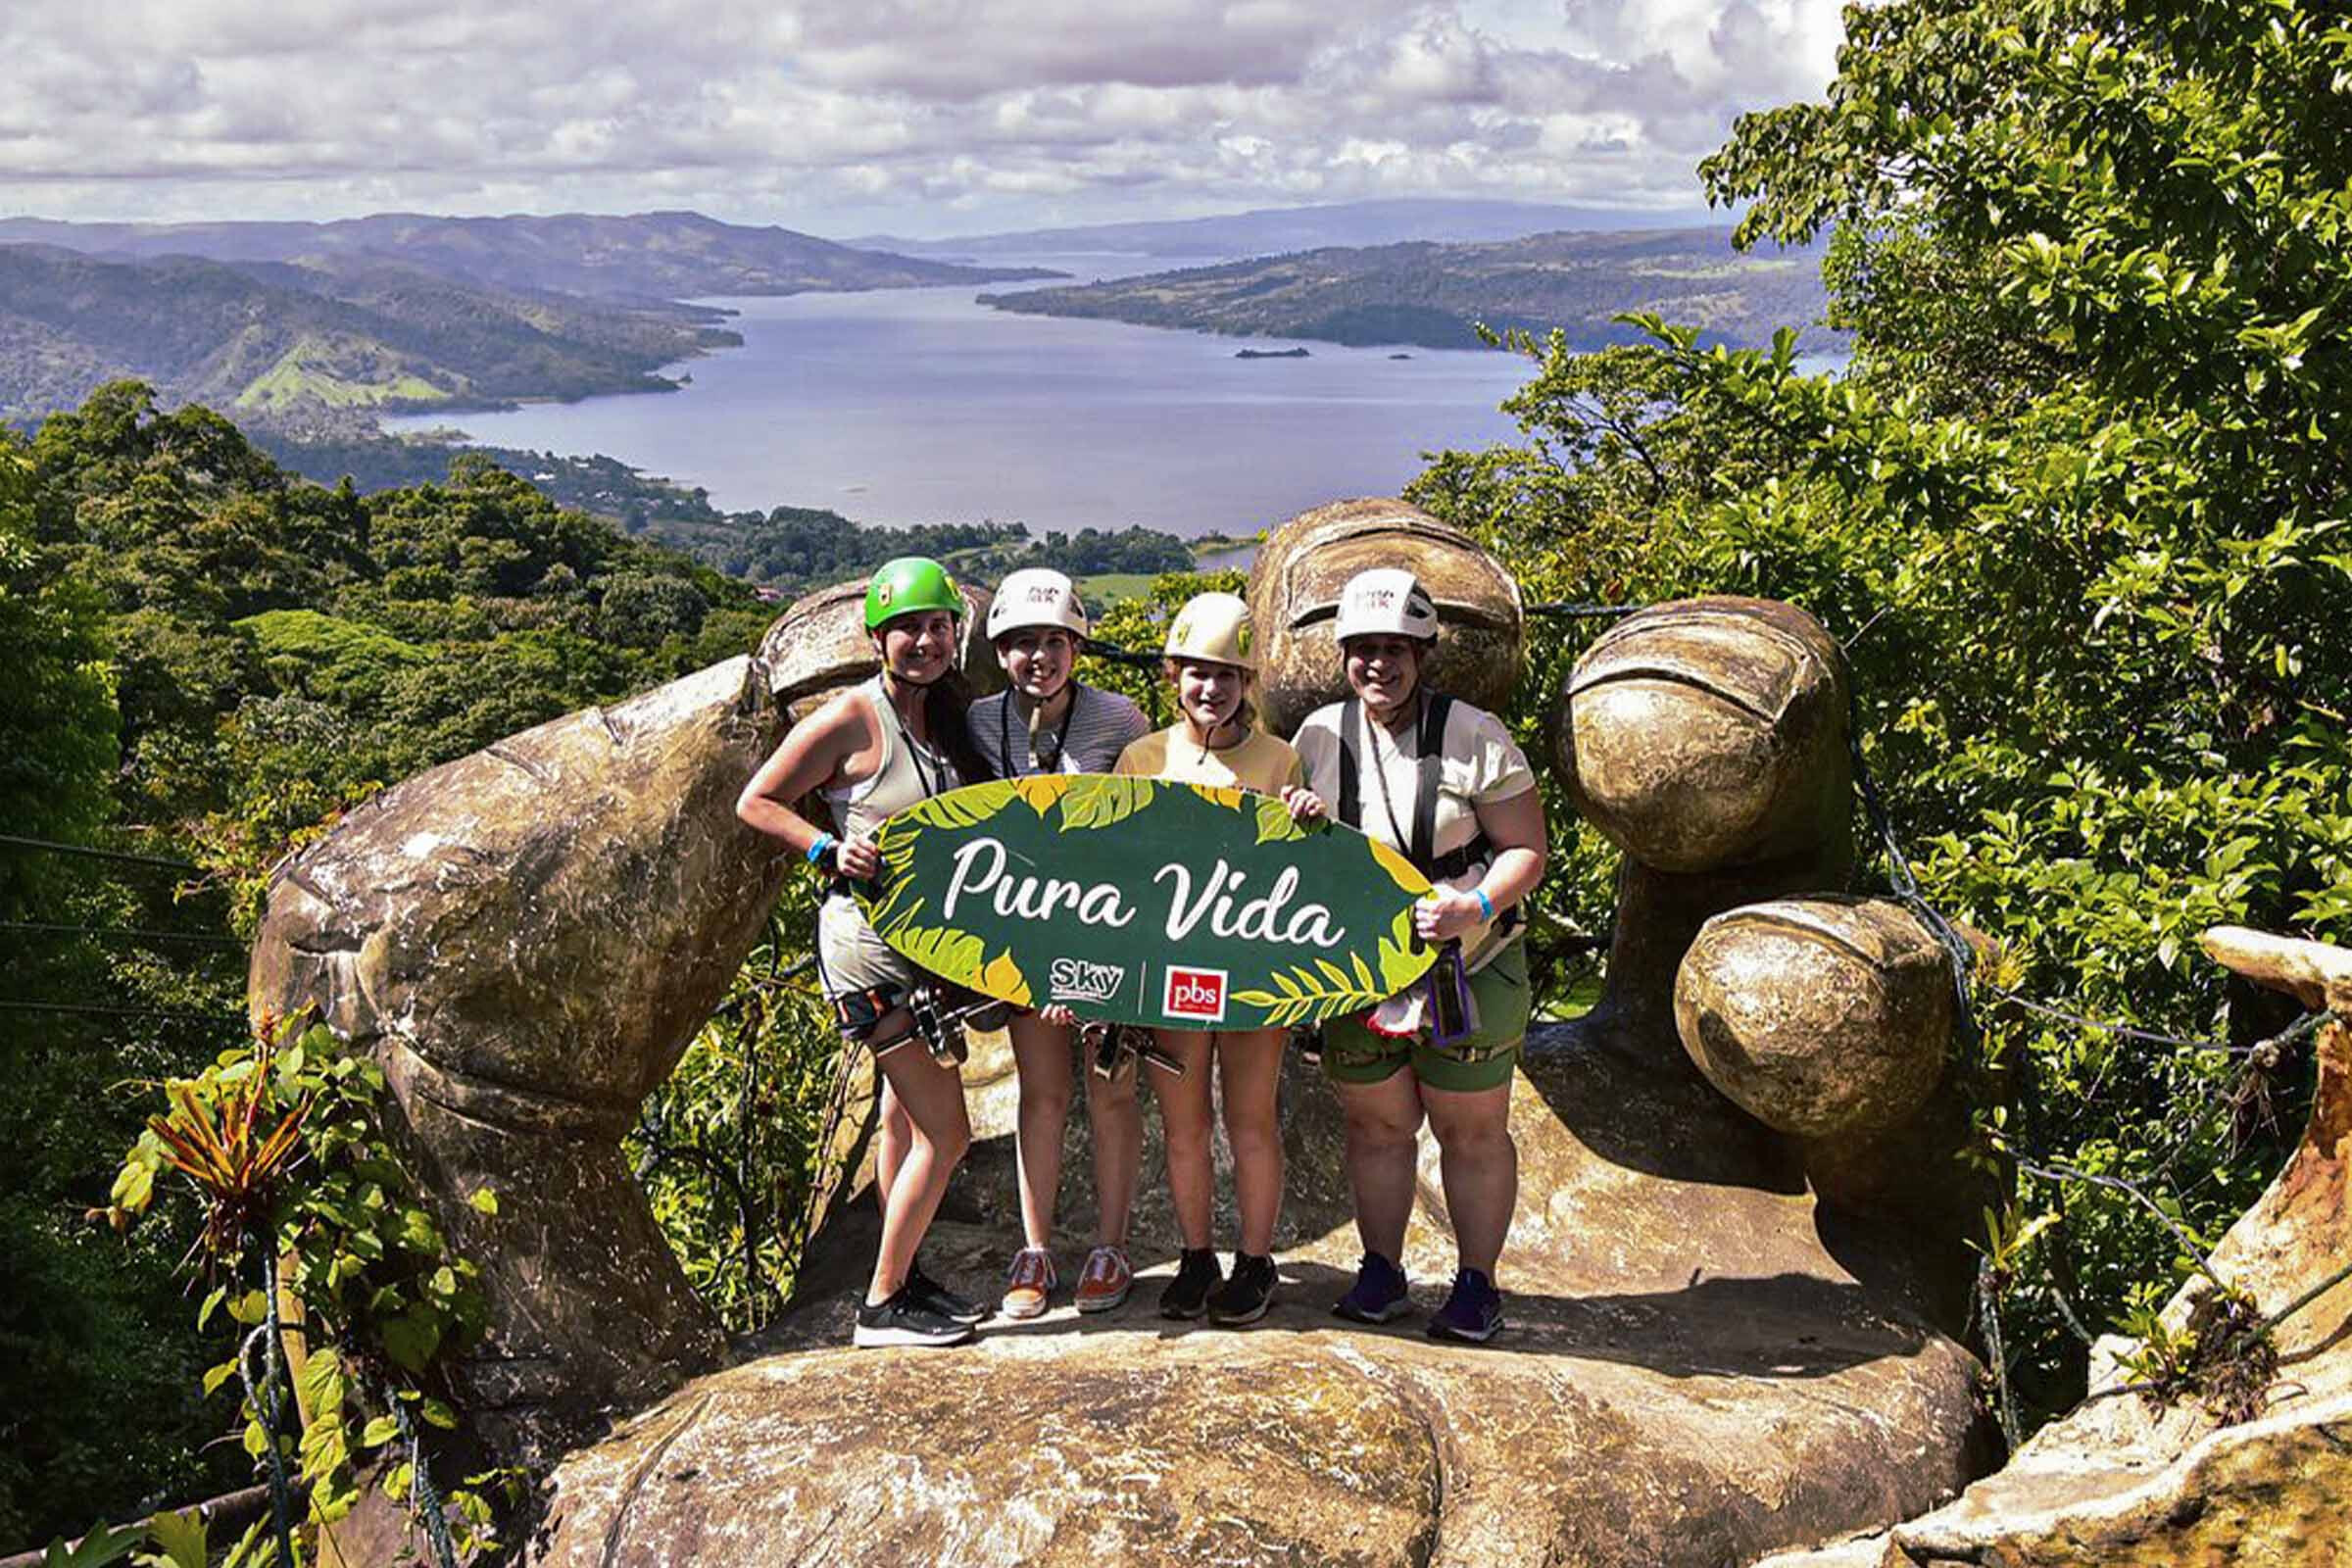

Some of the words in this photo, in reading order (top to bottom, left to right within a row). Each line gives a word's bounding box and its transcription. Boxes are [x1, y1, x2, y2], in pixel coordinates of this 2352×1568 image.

[944, 837, 1137, 927] Pura
[1153, 858, 1346, 948] Vida
[1050, 957, 1124, 1000] Sky
[1174, 976, 1216, 1007] pbs
